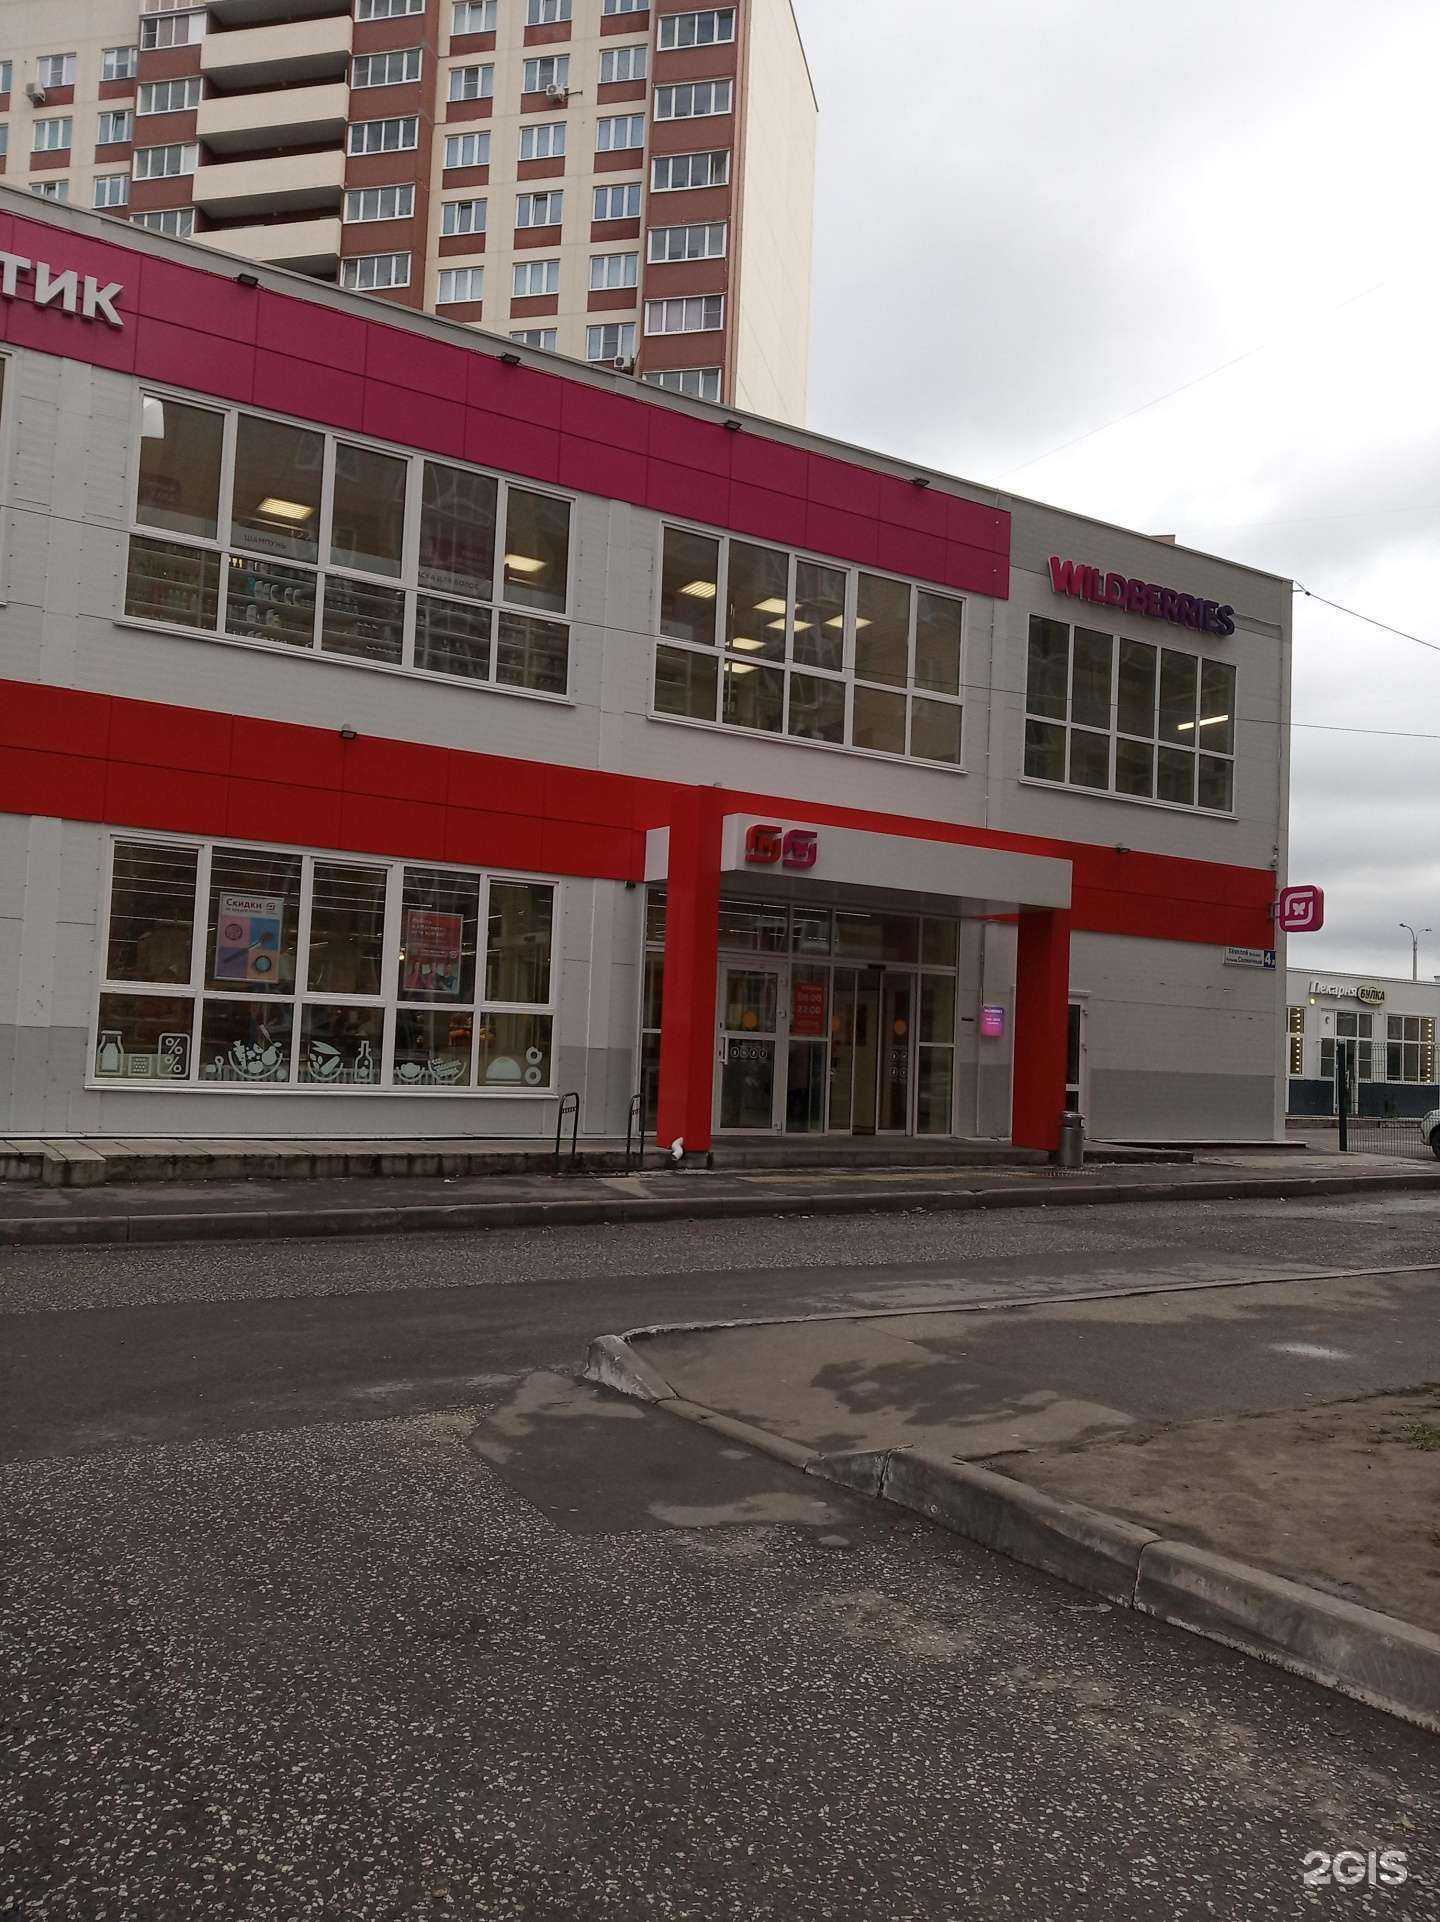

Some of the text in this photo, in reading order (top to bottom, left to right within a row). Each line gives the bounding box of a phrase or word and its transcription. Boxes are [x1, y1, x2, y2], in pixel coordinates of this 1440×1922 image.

[1048, 555, 1236, 636] WILDBERRIES
[1309, 980, 1385, 1001] Пекарня БУЛКА
